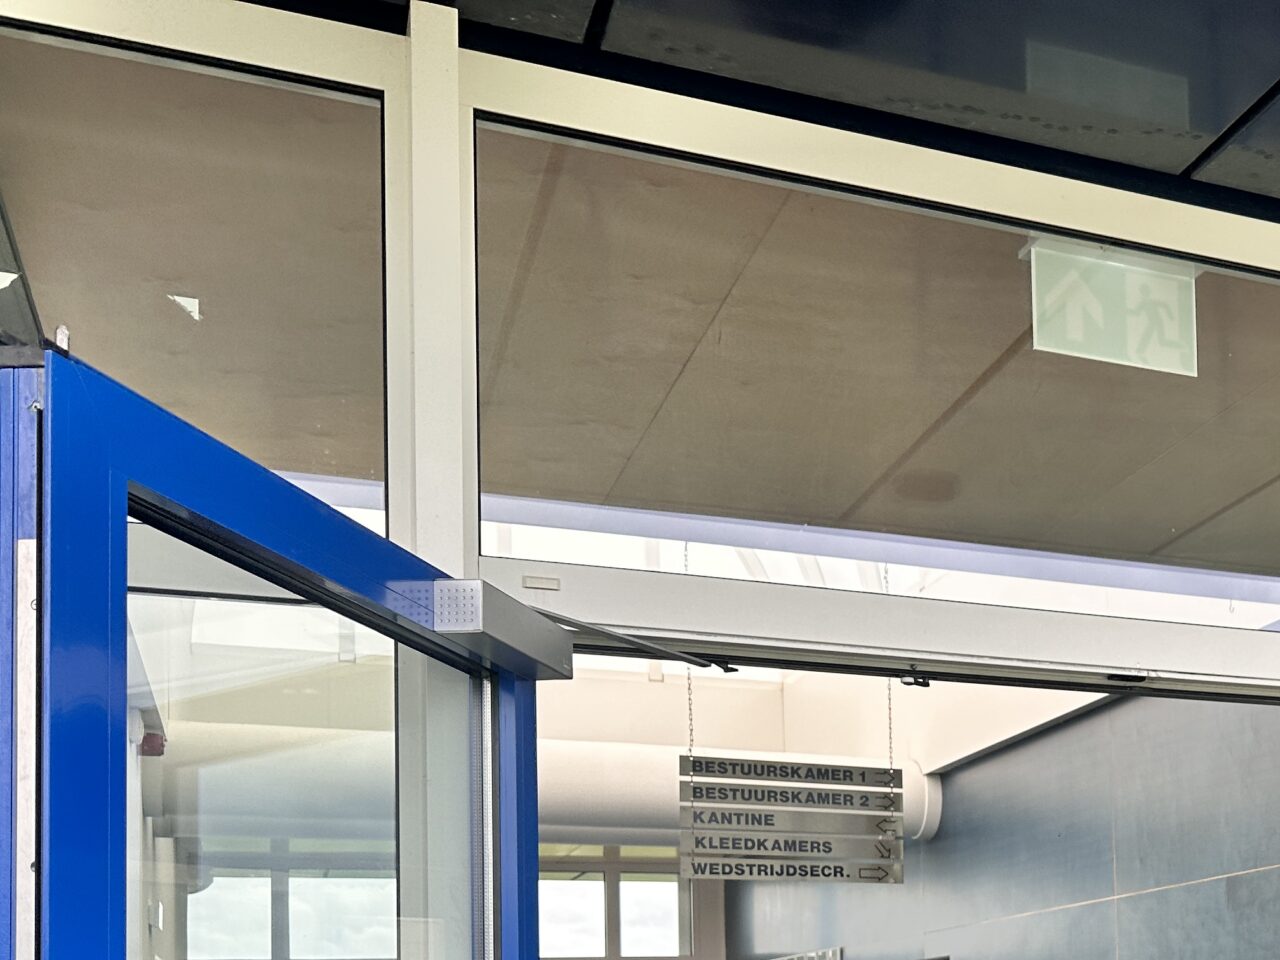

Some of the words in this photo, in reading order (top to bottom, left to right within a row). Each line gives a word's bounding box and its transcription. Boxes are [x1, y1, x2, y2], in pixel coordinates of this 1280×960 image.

[692, 759, 853, 782] BESTUURSKAMER
[859, 771, 867, 783] 1
[692, 785, 854, 806] BESTUURSKAMER
[859, 796, 869, 807] 2
[693, 811, 775, 826] KANTINE
[694, 836, 833, 853] KLEEDKAMERS
[691, 862, 851, 878] WEDSTRIJDSECR.
